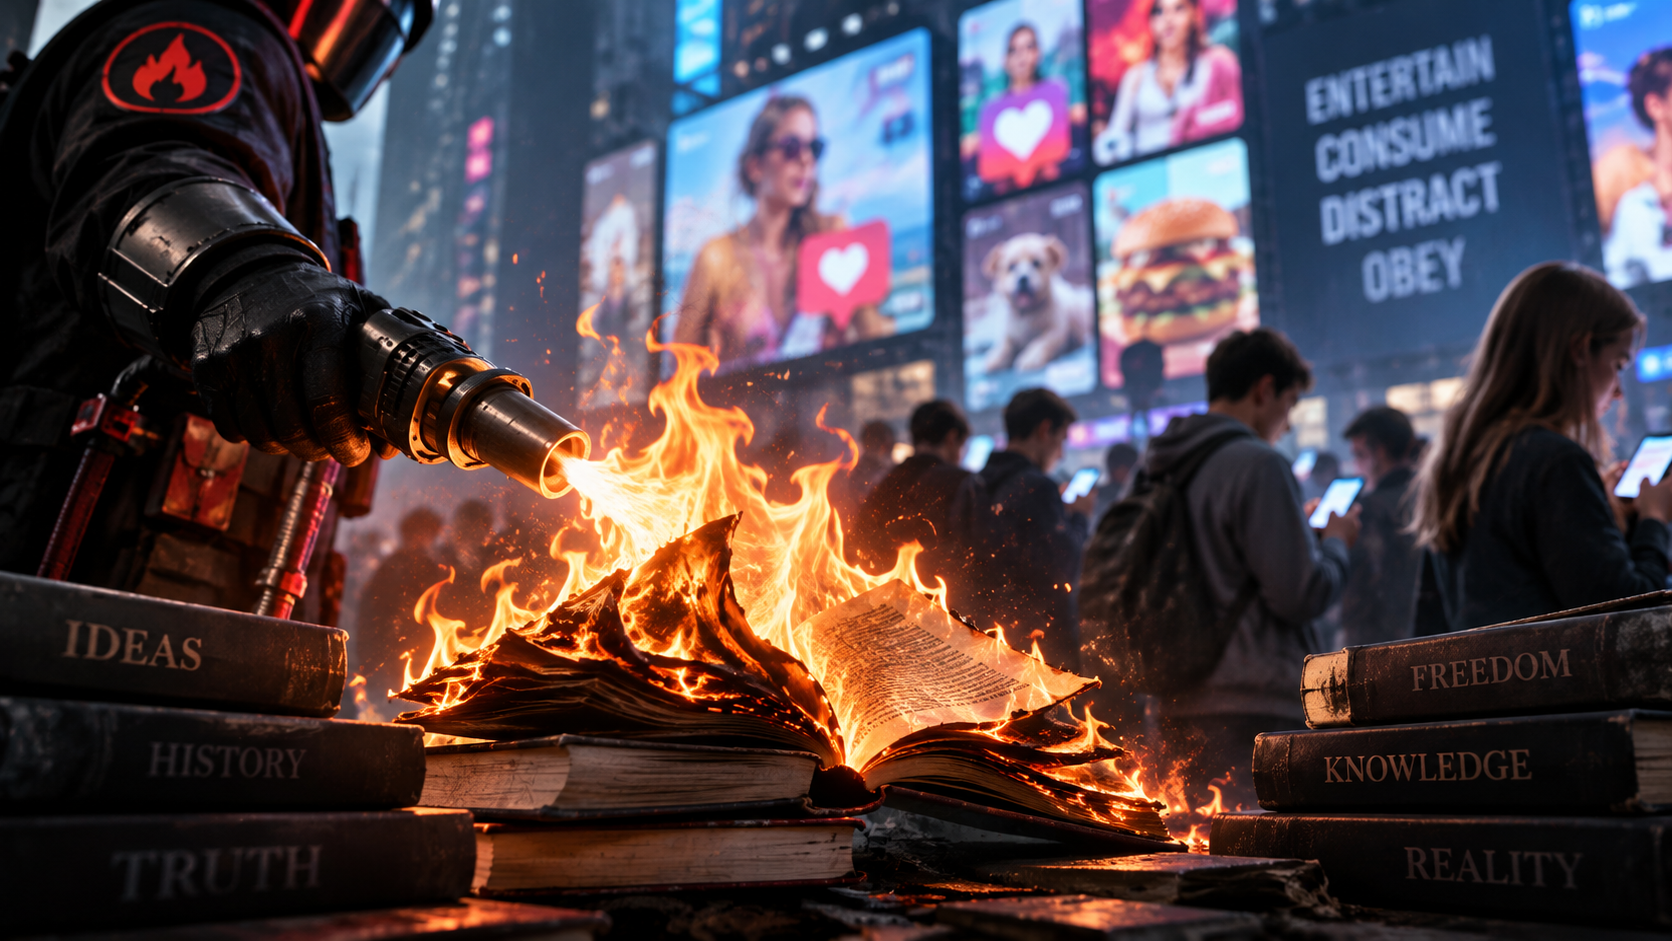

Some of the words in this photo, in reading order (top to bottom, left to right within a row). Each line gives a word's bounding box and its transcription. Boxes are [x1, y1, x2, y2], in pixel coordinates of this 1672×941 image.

[1306, 35, 1494, 124] ENTERTAIN
[1315, 97, 1497, 183] CONSUME
[1320, 161, 1501, 246] DISTRACT
[1361, 236, 1466, 303] OBEY
[63, 620, 203, 671] IDEAS
[1410, 648, 1573, 692] FREEDOM
[149, 742, 307, 779] HISTORY
[1323, 749, 1532, 783] KNOWLEDGE
[113, 845, 322, 902] TRUTH
[1405, 846, 1583, 889] REALITY
